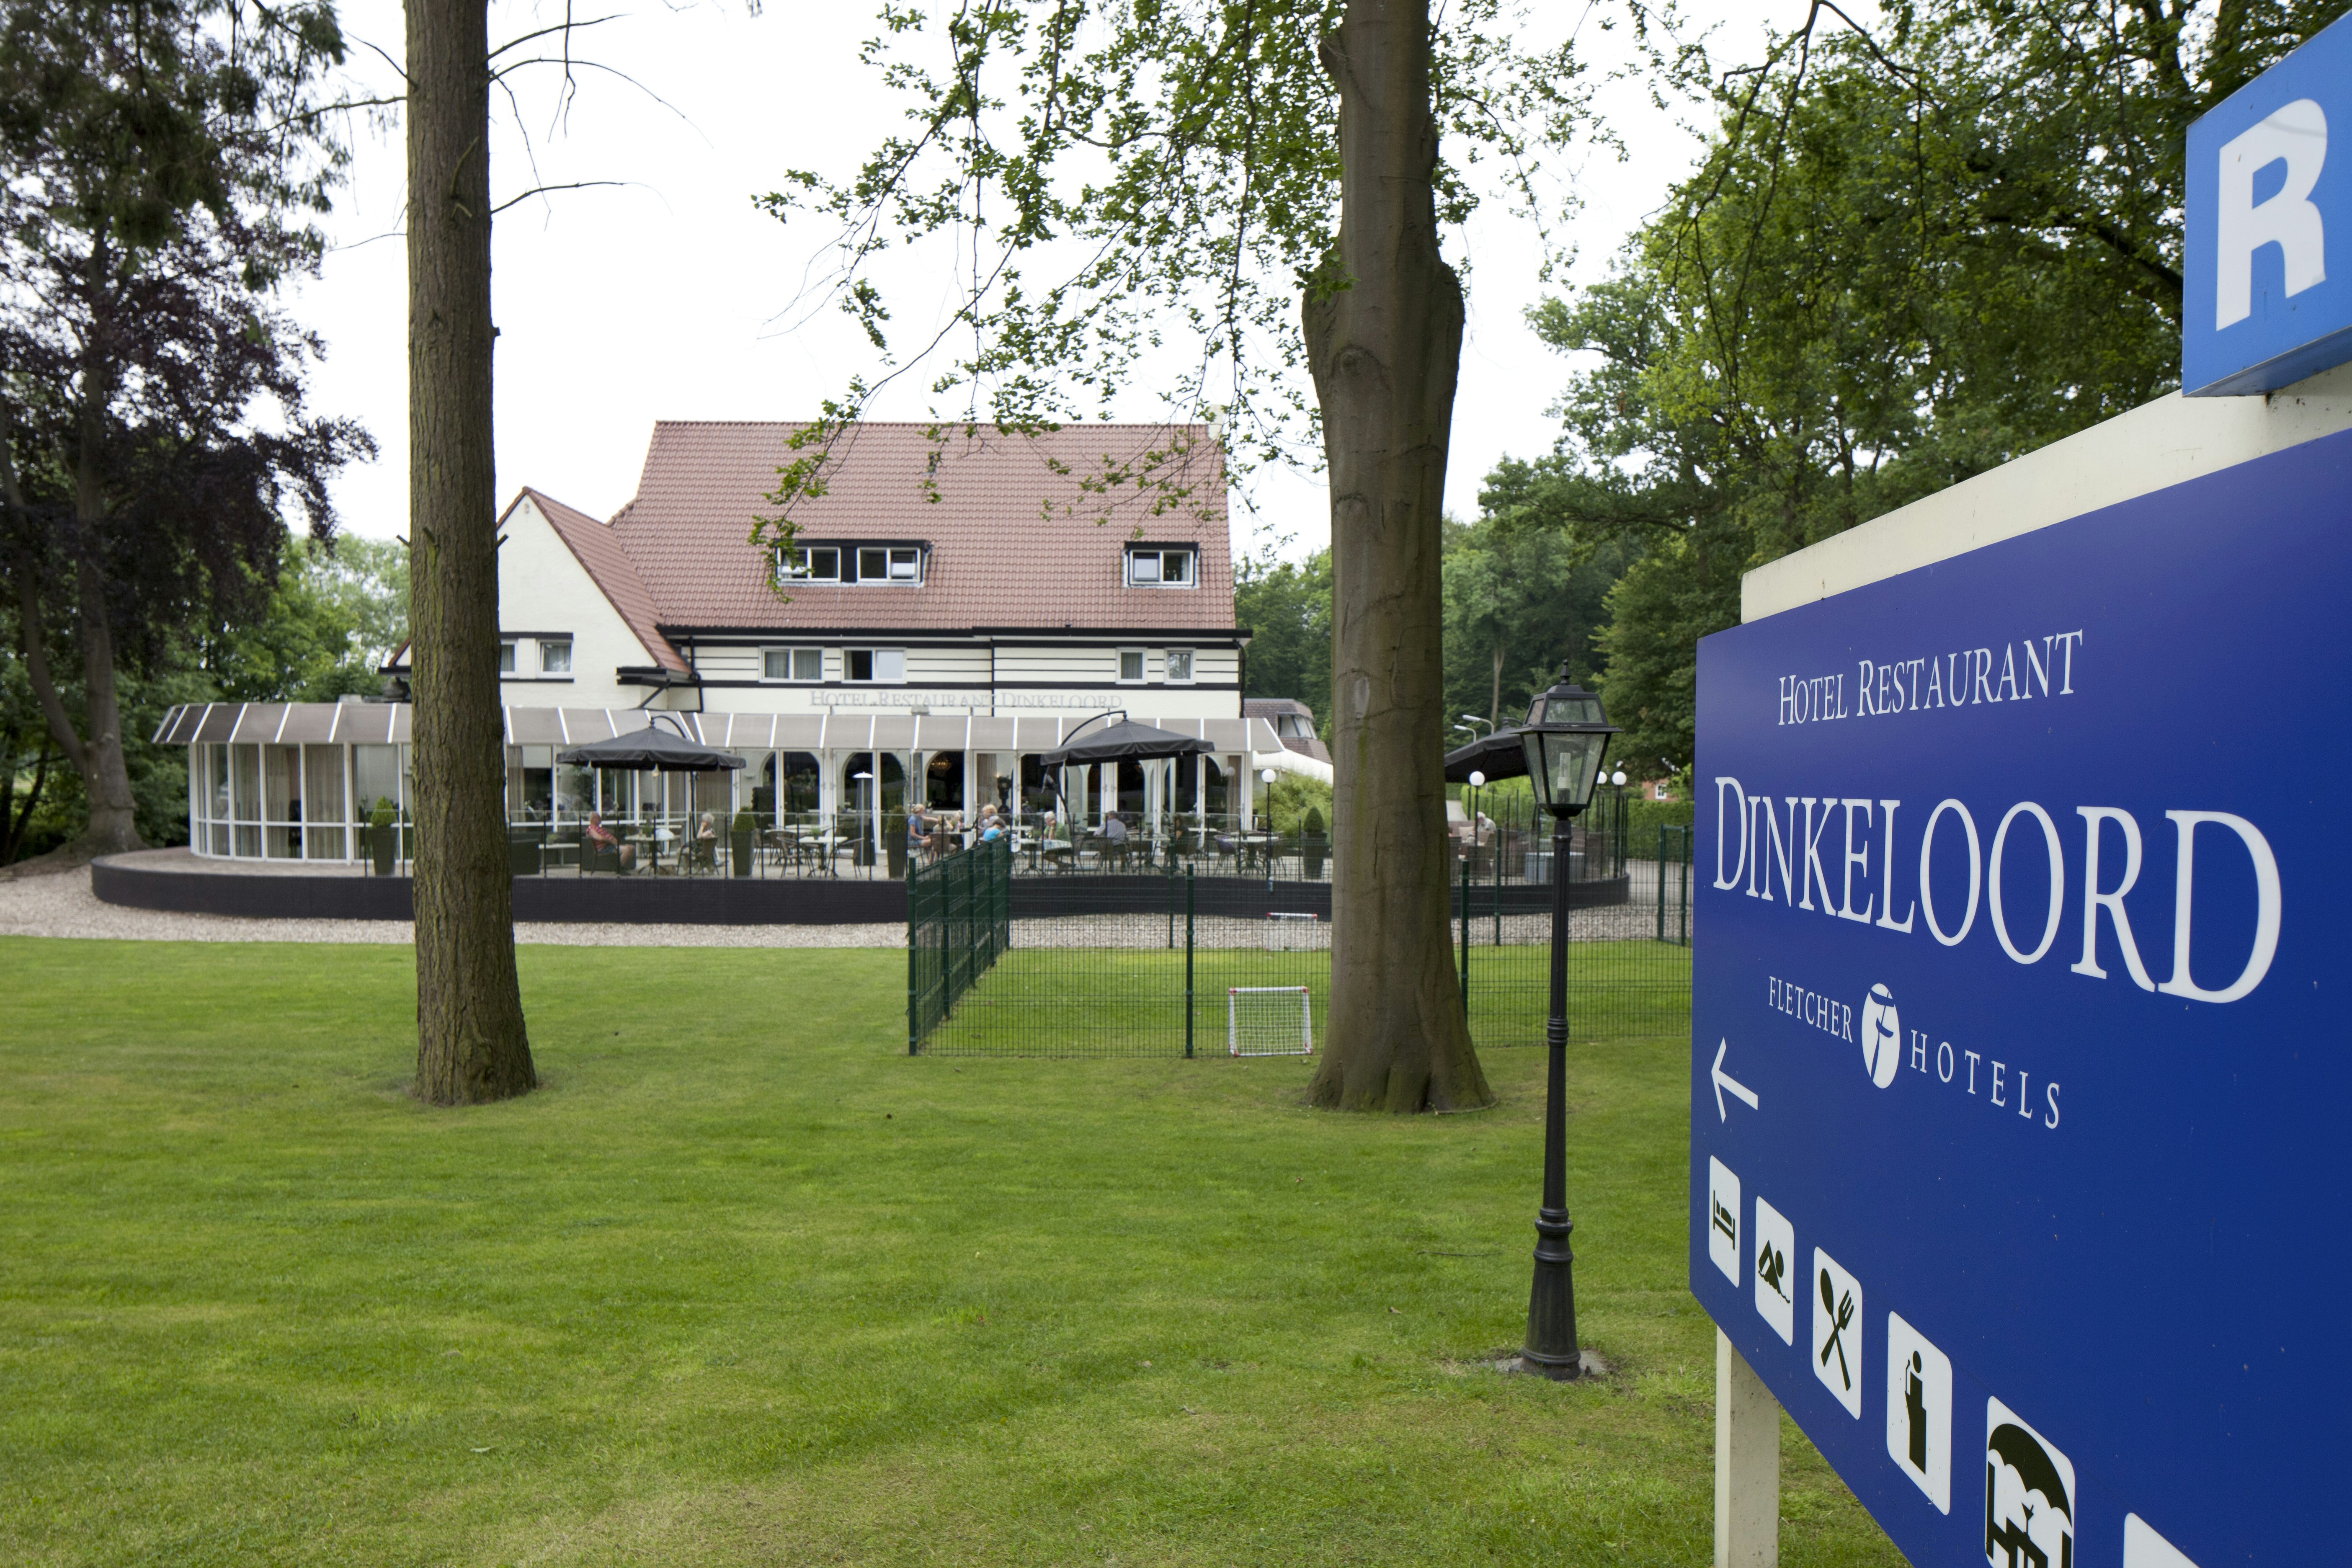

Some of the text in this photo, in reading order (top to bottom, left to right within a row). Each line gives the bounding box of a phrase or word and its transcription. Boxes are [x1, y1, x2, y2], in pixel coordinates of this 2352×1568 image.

[2216, 98, 2328, 331] R
[1001, 692, 1122, 708] DINKELOORD
[1778, 629, 2083, 725] HOTEL RESTAURANT
[1713, 776, 2281, 1003] DINKELOORD
[1769, 976, 2060, 1129] FLETCHER HOTELS
